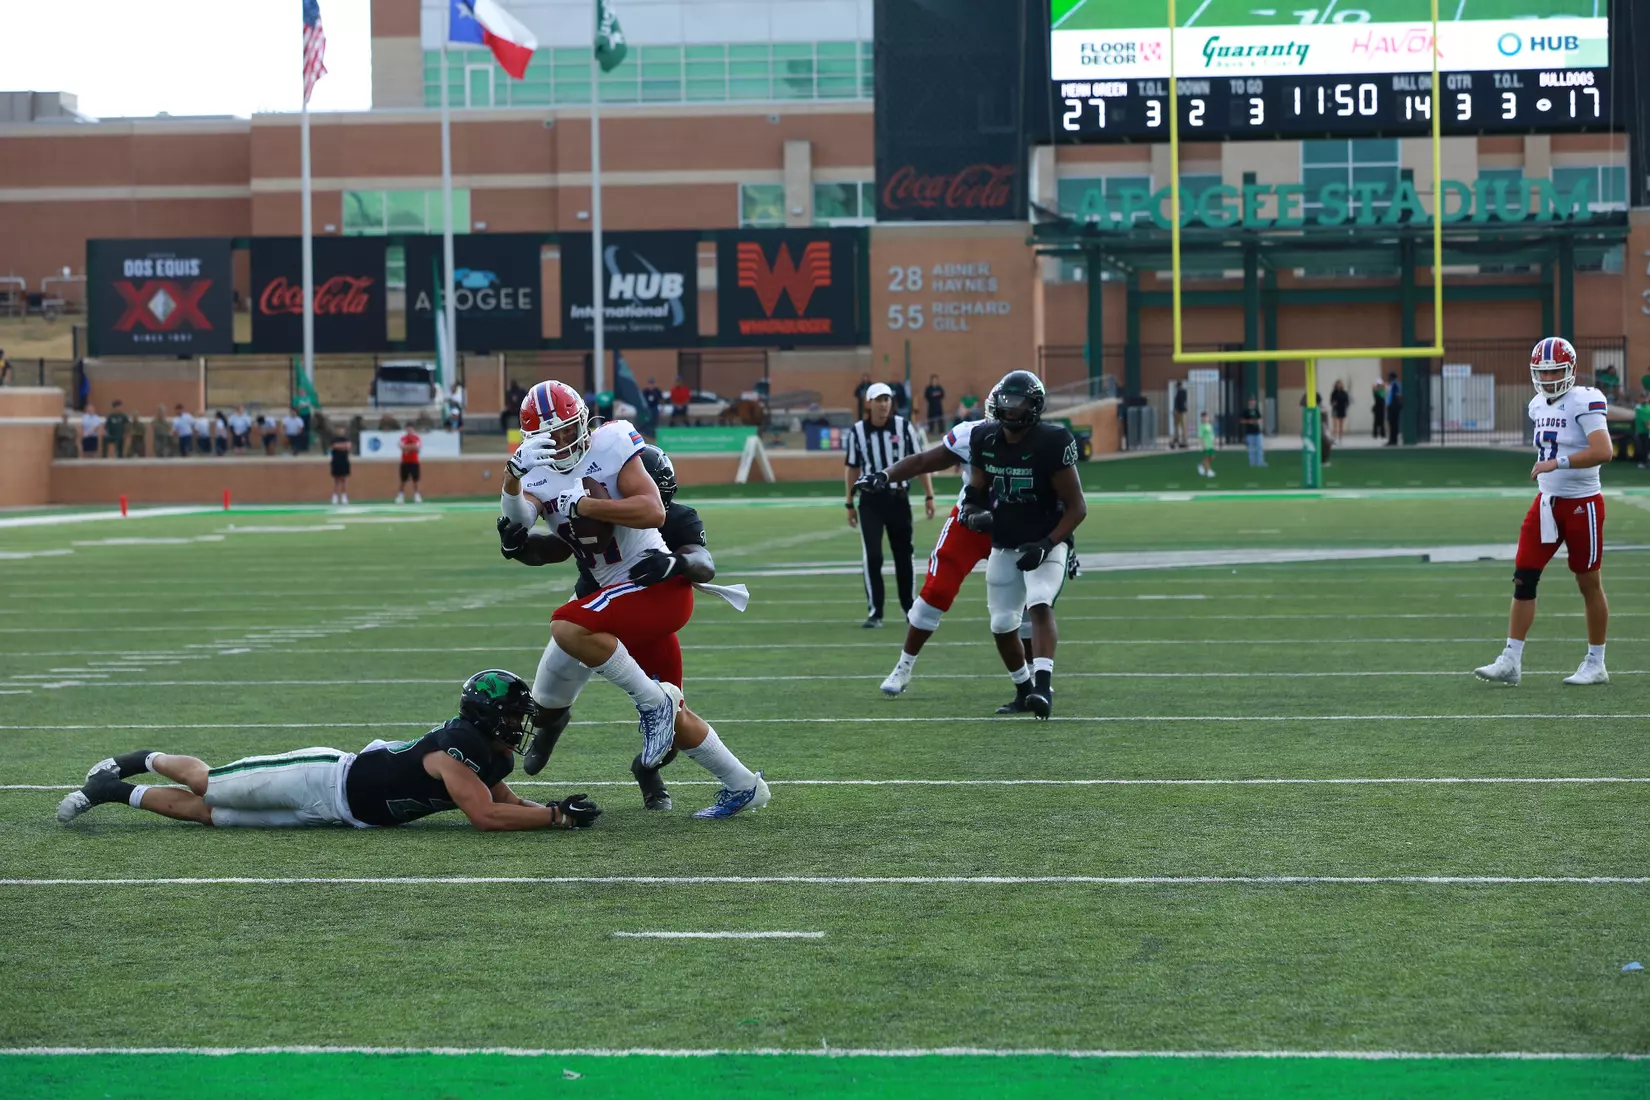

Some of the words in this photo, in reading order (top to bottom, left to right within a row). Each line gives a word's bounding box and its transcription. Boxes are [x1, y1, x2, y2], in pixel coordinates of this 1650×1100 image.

[1081, 42, 1136, 53] FLOOR
[1203, 36, 1310, 68] Guaranty
[1530, 36, 1579, 51] HUB
[1081, 54, 1136, 66] DECOR
[1177, 80, 1211, 95] DOWN
[1229, 80, 1245, 95] TO
[1246, 79, 1264, 95] GO
[1392, 76, 1417, 91] BALL
[1418, 75, 1433, 90] ON
[1447, 74, 1472, 90] QTR
[1539, 71, 1595, 87] BULLDOGS
[1249, 98, 1264, 125] 3
[1294, 83, 1378, 116] 11:50
[1405, 95, 1431, 120] 14
[1457, 93, 1471, 120] 3
[1502, 92, 1516, 119] 3
[1569, 87, 1600, 118] 17
[1063, 98, 1106, 131] 27
[1146, 100, 1161, 127] 3
[1189, 99, 1205, 126] 2
[883, 164, 1016, 210] Coca-Cola
[1074, 184, 1306, 230] APOGEE
[1317, 176, 1592, 226] STADIUM
[123, 259, 153, 278] DOS
[156, 258, 201, 278] EQUIS
[887, 266, 923, 292] 28
[932, 264, 990, 276] ABNER
[609, 272, 685, 300] HUB
[932, 278, 998, 292] HAYNES
[414, 287, 533, 311] AOGEE
[570, 303, 669, 319] Intnational
[932, 302, 1011, 316] RICHARD
[887, 304, 925, 330] 55
[933, 318, 971, 331] GILL
[1534, 418, 1567, 429] LLDOGS
[1536, 430, 1559, 461] 17
[526, 478, 548, 488] C-USA
